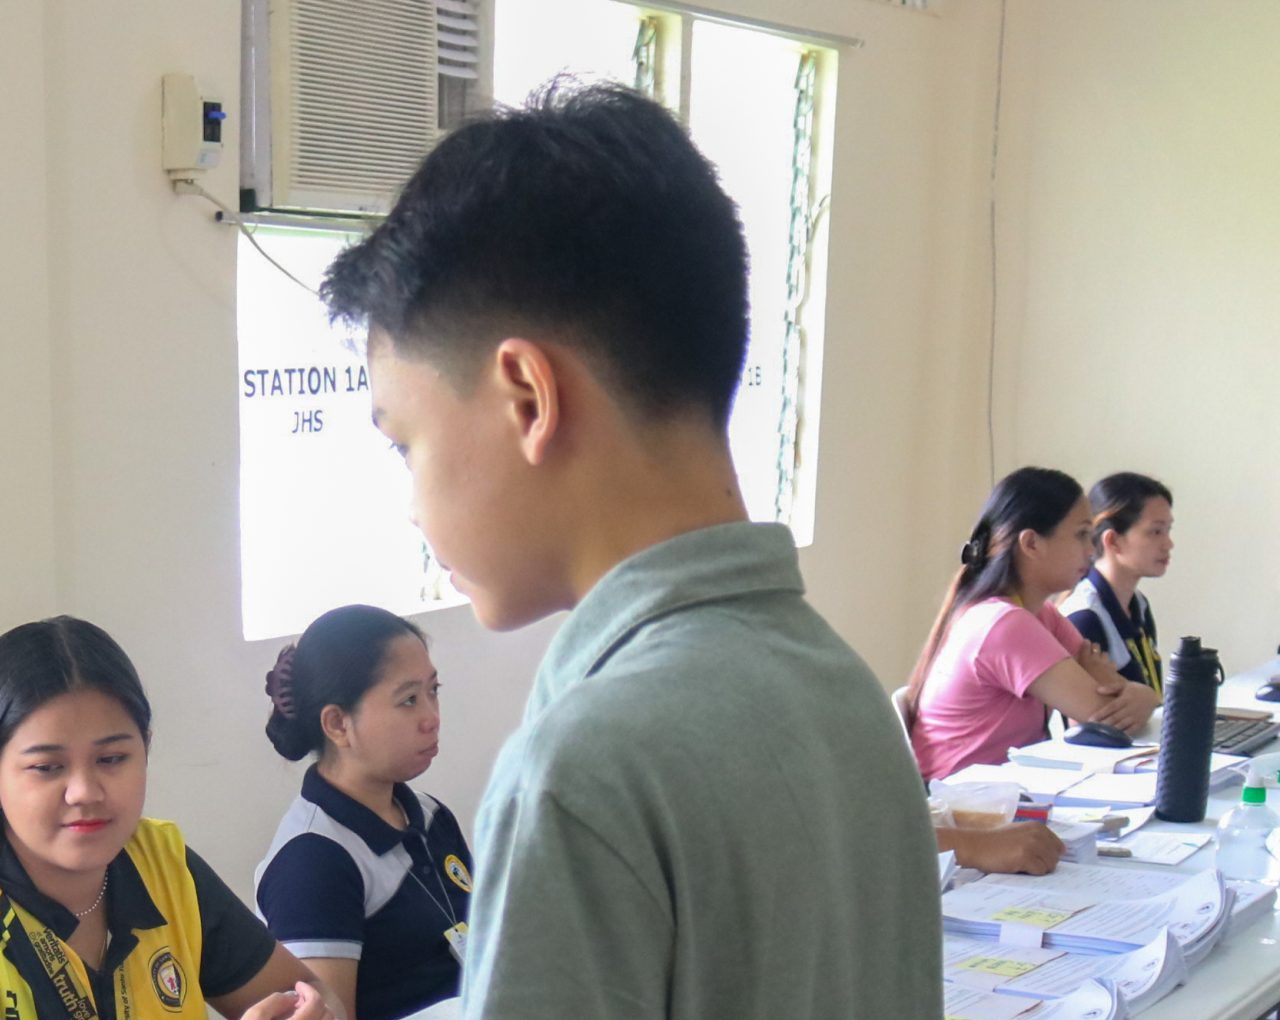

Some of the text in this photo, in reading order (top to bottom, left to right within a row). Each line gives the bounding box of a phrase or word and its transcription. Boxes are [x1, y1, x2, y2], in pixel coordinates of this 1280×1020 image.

[244, 365, 369, 397] STATION 1A
[292, 409, 323, 434] JHS
[53, 974, 79, 1012] truth
[77, 997, 91, 1018] love
